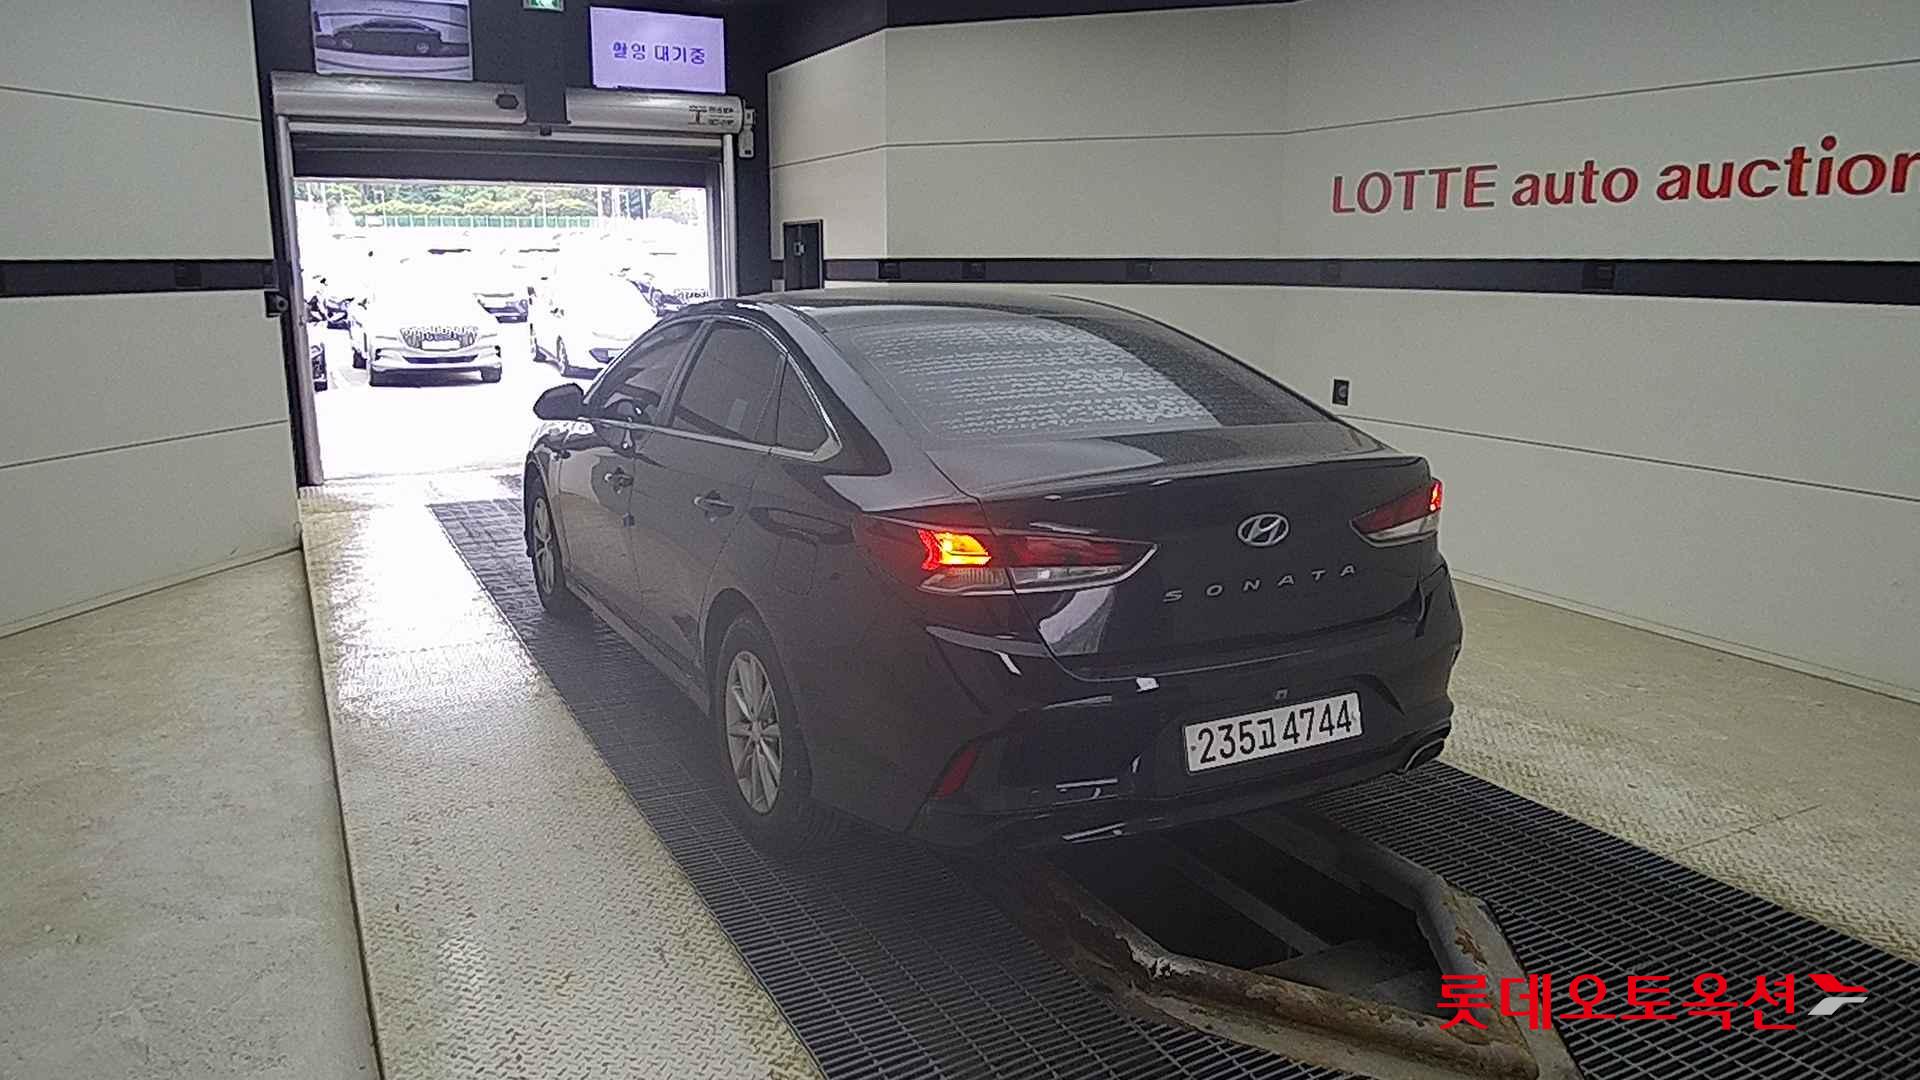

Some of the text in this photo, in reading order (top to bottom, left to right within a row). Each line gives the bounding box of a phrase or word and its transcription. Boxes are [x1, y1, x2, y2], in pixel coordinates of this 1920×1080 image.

[654, 45, 705, 65] 대기중
[1331, 164, 1499, 214] LOTTE
[1511, 159, 1639, 206] auto
[1162, 563, 1357, 603] SONATA
